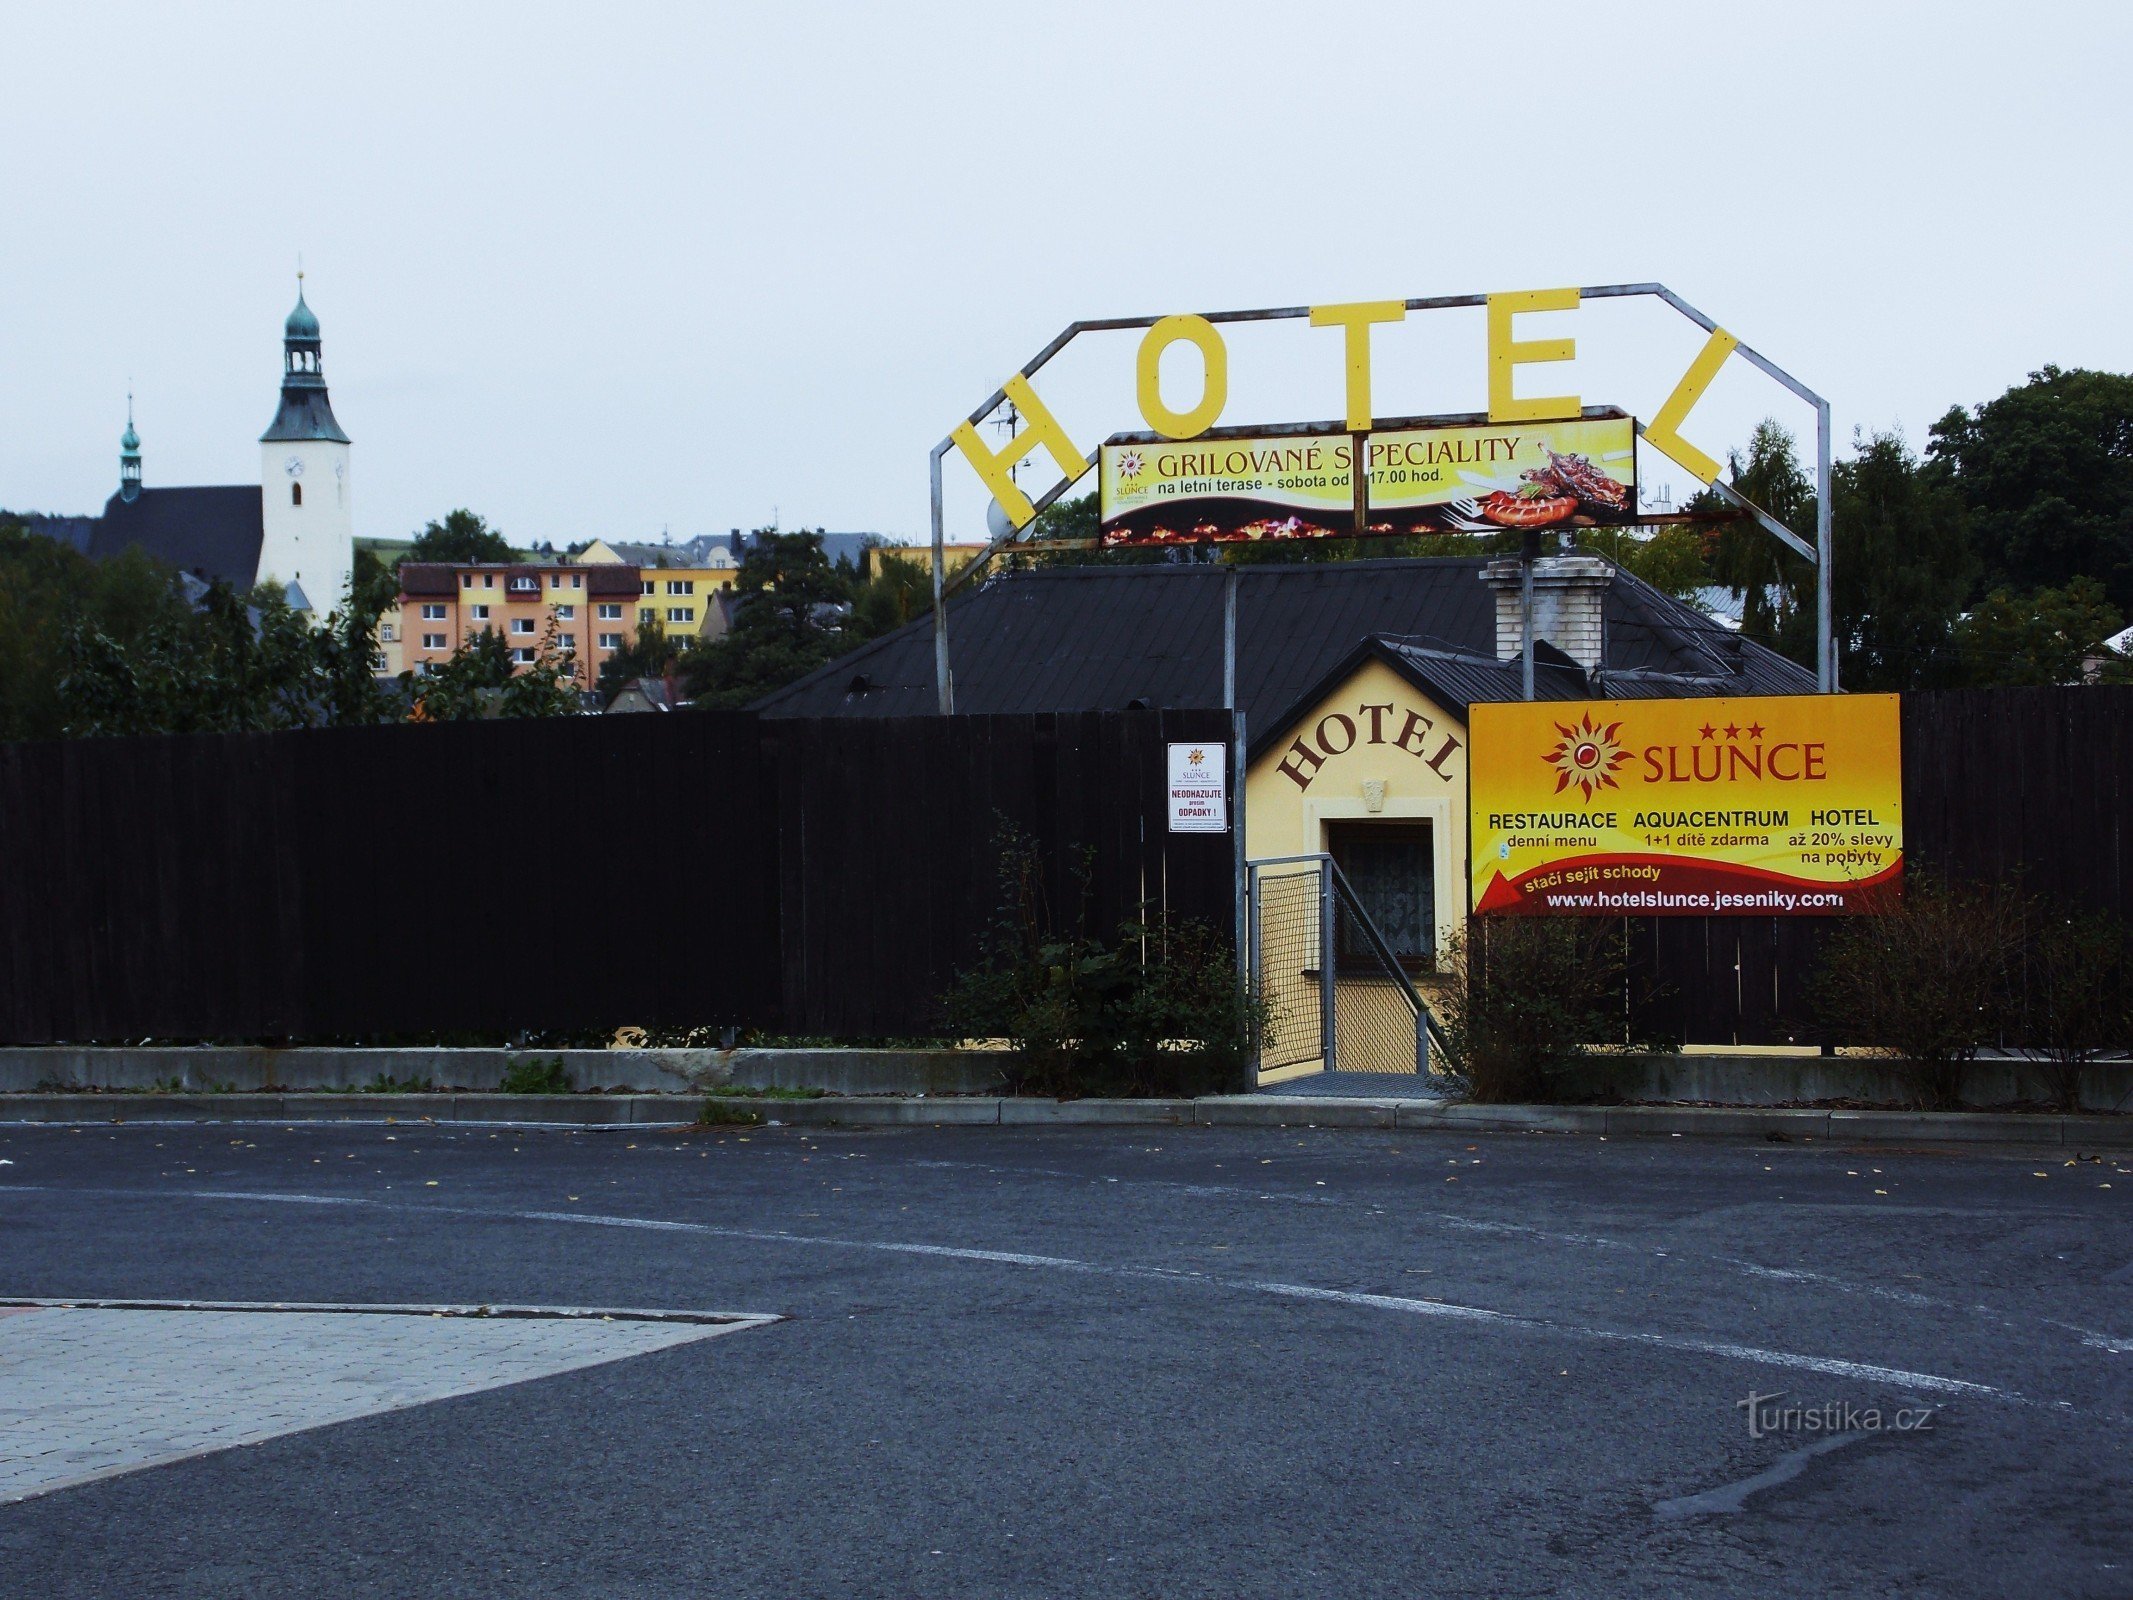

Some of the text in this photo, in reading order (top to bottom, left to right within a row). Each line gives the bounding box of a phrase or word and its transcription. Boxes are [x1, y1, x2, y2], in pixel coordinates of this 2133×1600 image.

[951, 288, 1738, 529] HOTEL
[1157, 441, 1323, 478] GRILOVANÉ
[1158, 483, 1175, 494] na
[1180, 479, 1212, 493] letní
[1217, 478, 1262, 492] terase
[1277, 475, 1326, 488] sobota
[1331, 473, 1349, 486] od
[1369, 470, 1406, 484] 17.00
[1412, 468, 1444, 481] hod.
[1276, 703, 1463, 793] HOTEL
[1643, 743, 1827, 782] SLUNCE
[1171, 789, 1222, 798] NEODHAZUJTE
[1178, 808, 1212, 816] ODPADKY
[1489, 809, 1880, 829] RESTAURACE AQUACENTRUM HOTEL
[1507, 834, 1597, 847] denní menu
[1644, 833, 1769, 846] 1+1 dítě zdarma
[1788, 832, 1894, 848] až 20% slevy
[1801, 850, 1882, 866] na pobyty
[1525, 865, 1661, 892] stačí sejít schody
[1547, 890, 1844, 910] www.hotelslunce.jeseniky.com
